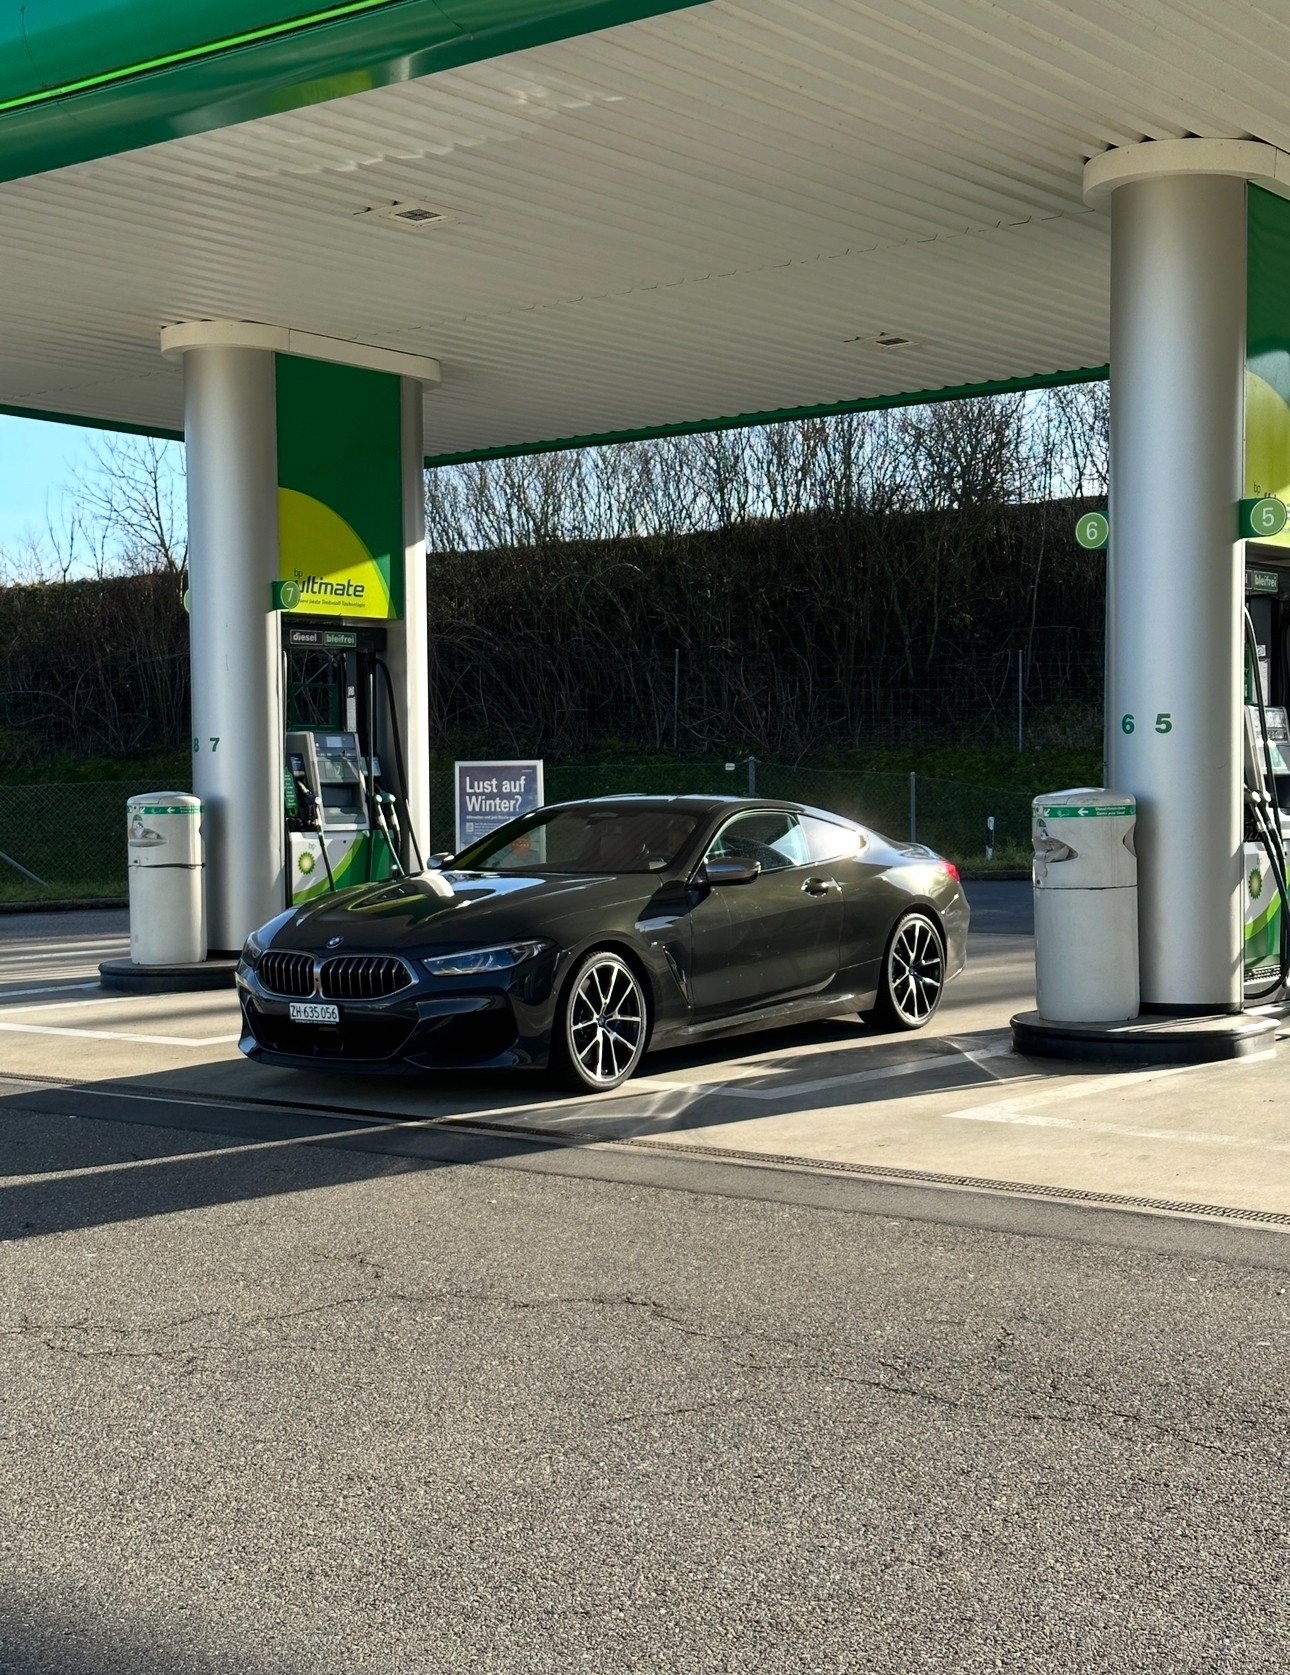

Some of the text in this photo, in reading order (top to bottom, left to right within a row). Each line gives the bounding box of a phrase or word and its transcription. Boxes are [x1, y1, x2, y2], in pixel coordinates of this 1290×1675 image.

[1262, 507, 1275, 527] 5
[1086, 521, 1098, 540] 6
[294, 568, 303, 578] bp
[1254, 573, 1277, 588] bleifrei
[286, 587, 294, 602] 7
[292, 631, 355, 645] diesel bleifrei
[1121, 713, 1173, 735] 6 5
[209, 737, 220, 752] 7
[465, 775, 526, 793] Lust auf
[465, 795, 522, 812] Winter?
